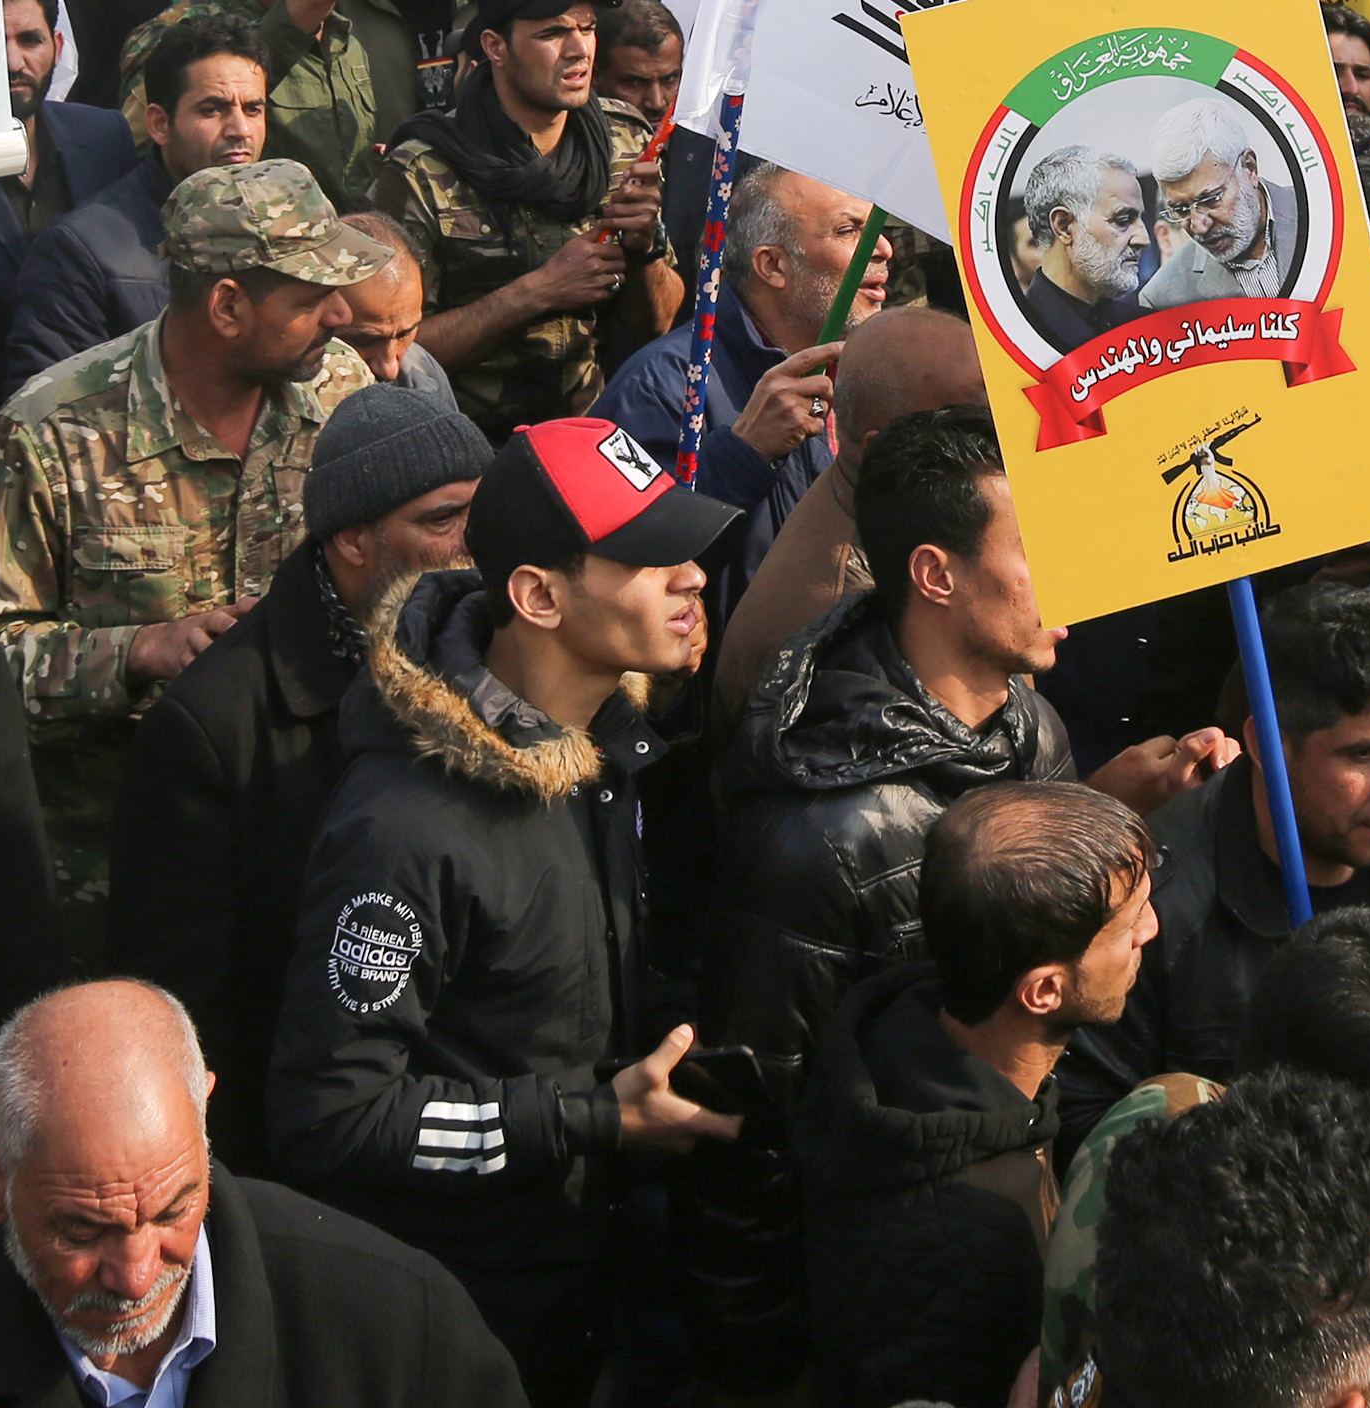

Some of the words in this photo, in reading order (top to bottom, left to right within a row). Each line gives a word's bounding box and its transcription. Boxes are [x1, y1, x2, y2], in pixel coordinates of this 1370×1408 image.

[1166, 316, 1256, 363] سليماني
[1259, 311, 1301, 340] كلنا
[1070, 336, 1164, 402] والمهندس
[1167, 538, 1199, 563] الله
[337, 904, 354, 927] DIE
[351, 892, 394, 909] MARKE
[393, 901, 416, 922] MIT
[409, 922, 423, 948] DEN
[350, 921, 358, 933] 3
[360, 924, 407, 947] RIEMEN
[339, 938, 409, 967] adidas
[328, 958, 342, 990] WITH
[337, 989, 359, 1012] THE
[360, 1002, 369, 1013] 3
[372, 972, 410, 1012] STRIPES
[339, 960, 359, 977] THE
[360, 968, 400, 983] BRAND
